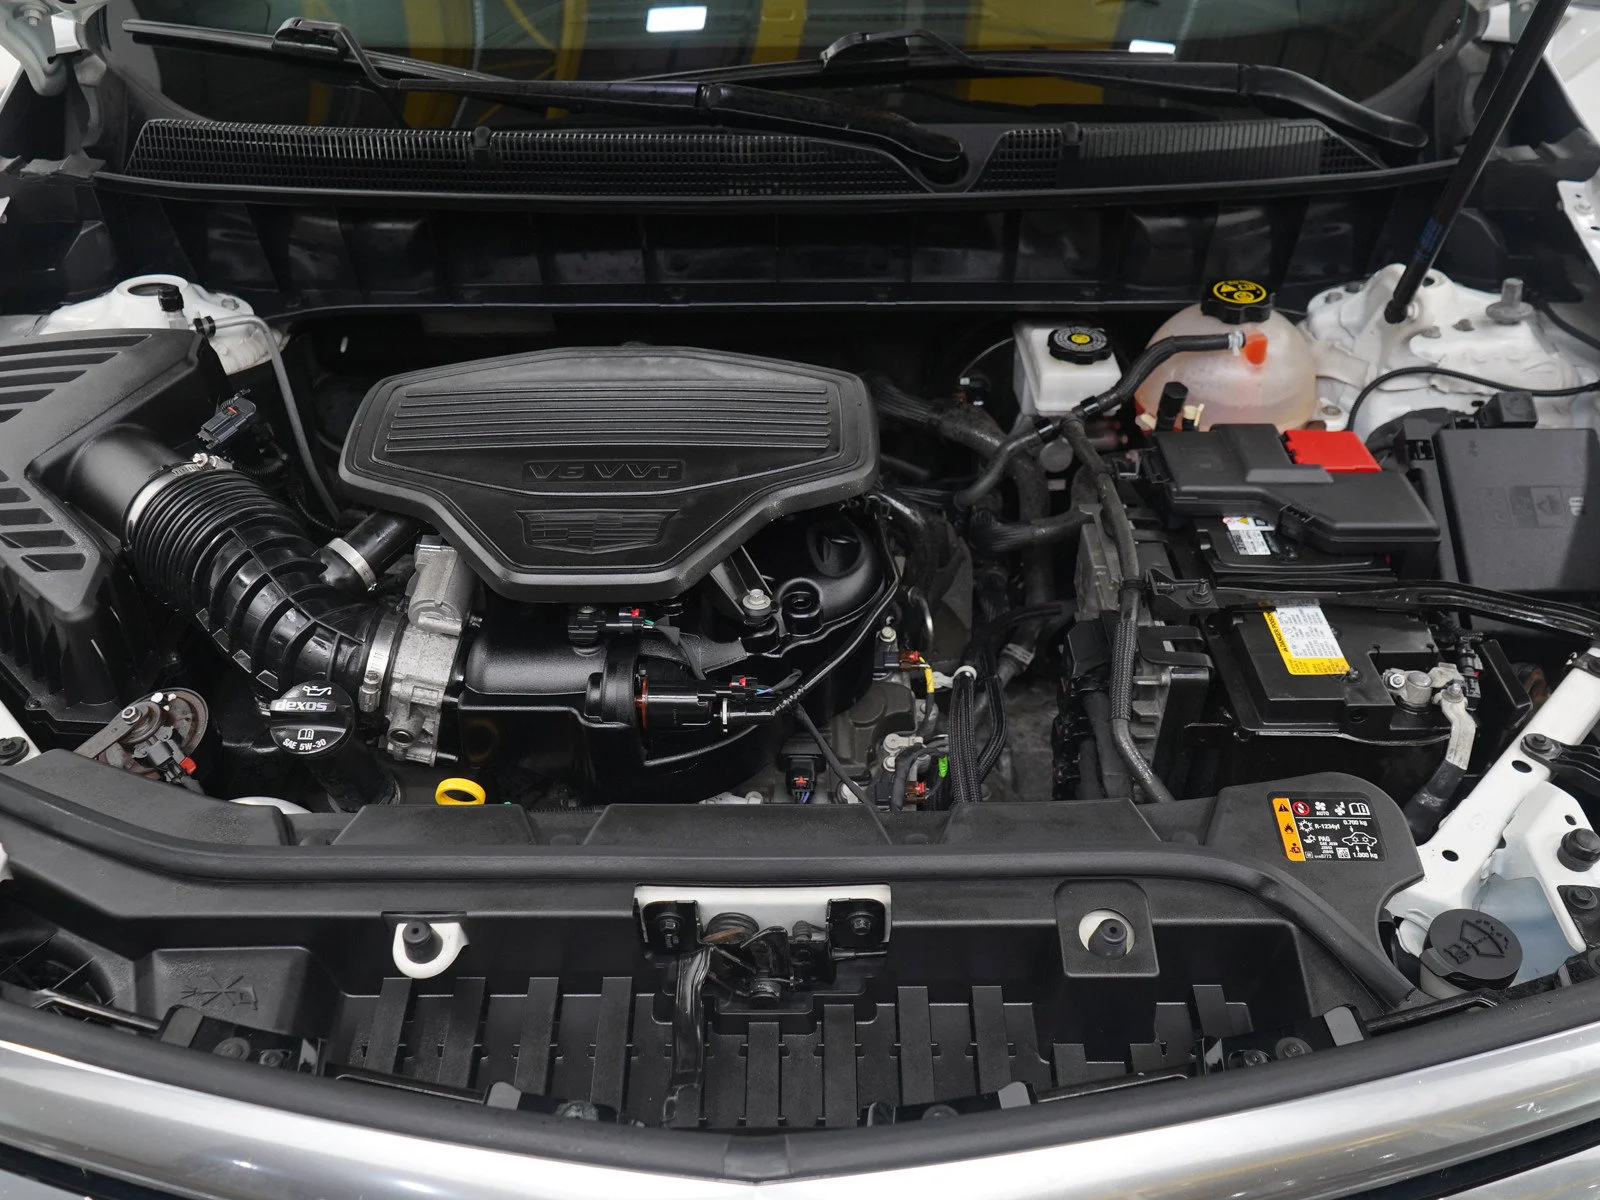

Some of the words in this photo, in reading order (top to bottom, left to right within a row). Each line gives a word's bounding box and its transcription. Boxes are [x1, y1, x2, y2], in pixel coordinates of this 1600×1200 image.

[529, 464, 585, 479] V6
[593, 464, 678, 479] VVT
[275, 699, 328, 712] dexos
[282, 738, 298, 750] SAE
[299, 739, 327, 751] 5W-30
